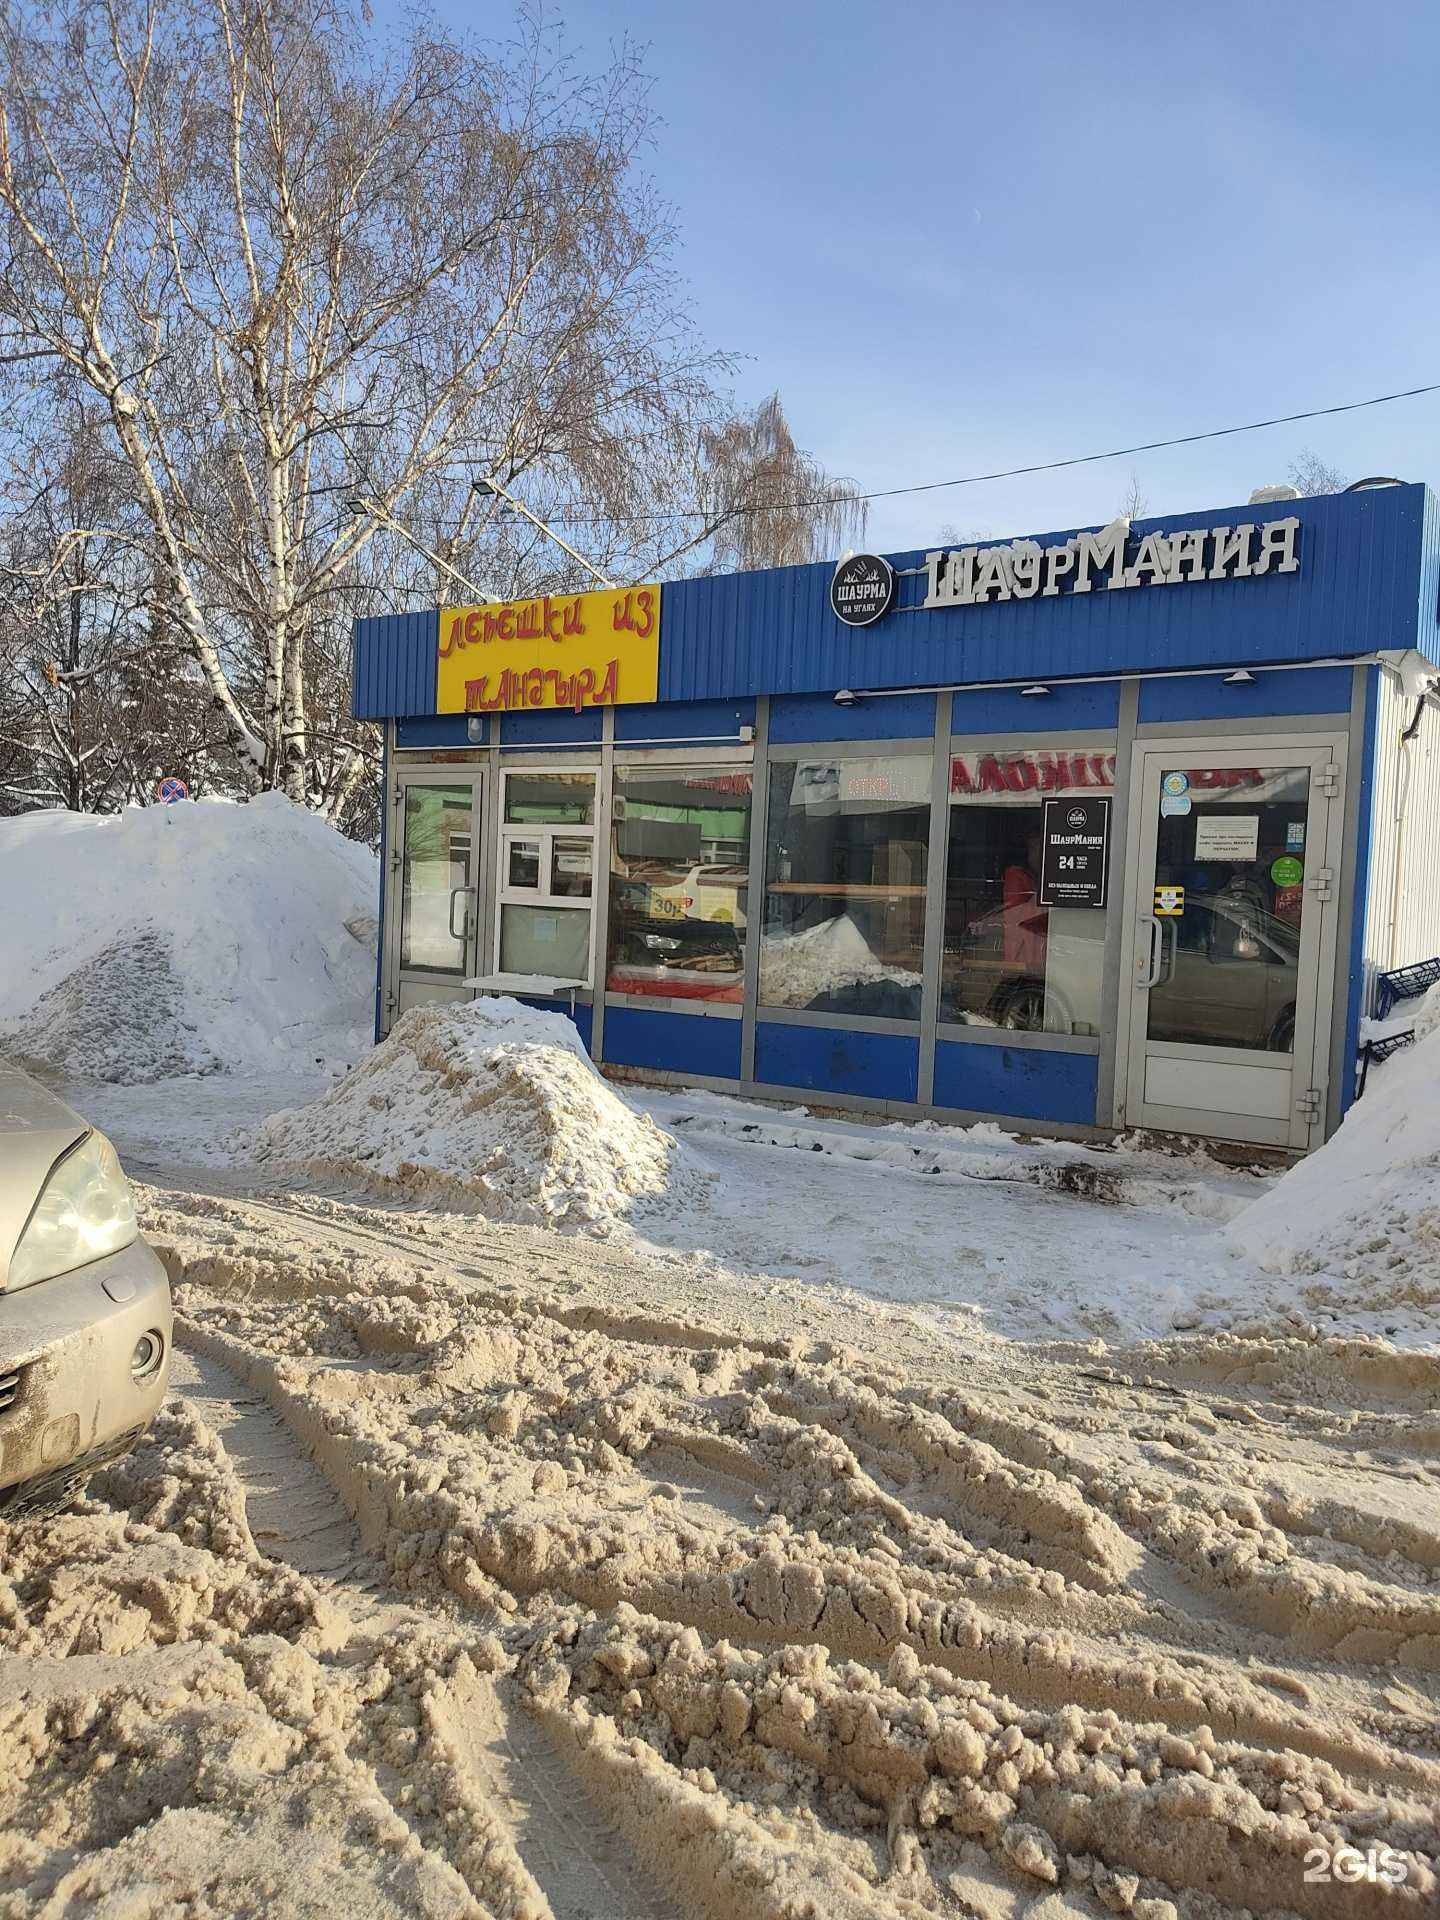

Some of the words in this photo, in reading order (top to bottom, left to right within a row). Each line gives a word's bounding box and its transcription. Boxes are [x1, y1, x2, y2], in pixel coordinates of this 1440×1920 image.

[837, 582, 887, 601] ШАУРМА
[842, 605, 852, 614] НА
[853, 603, 876, 613] УГЛЯХ
[1059, 855, 1074, 870] 24
